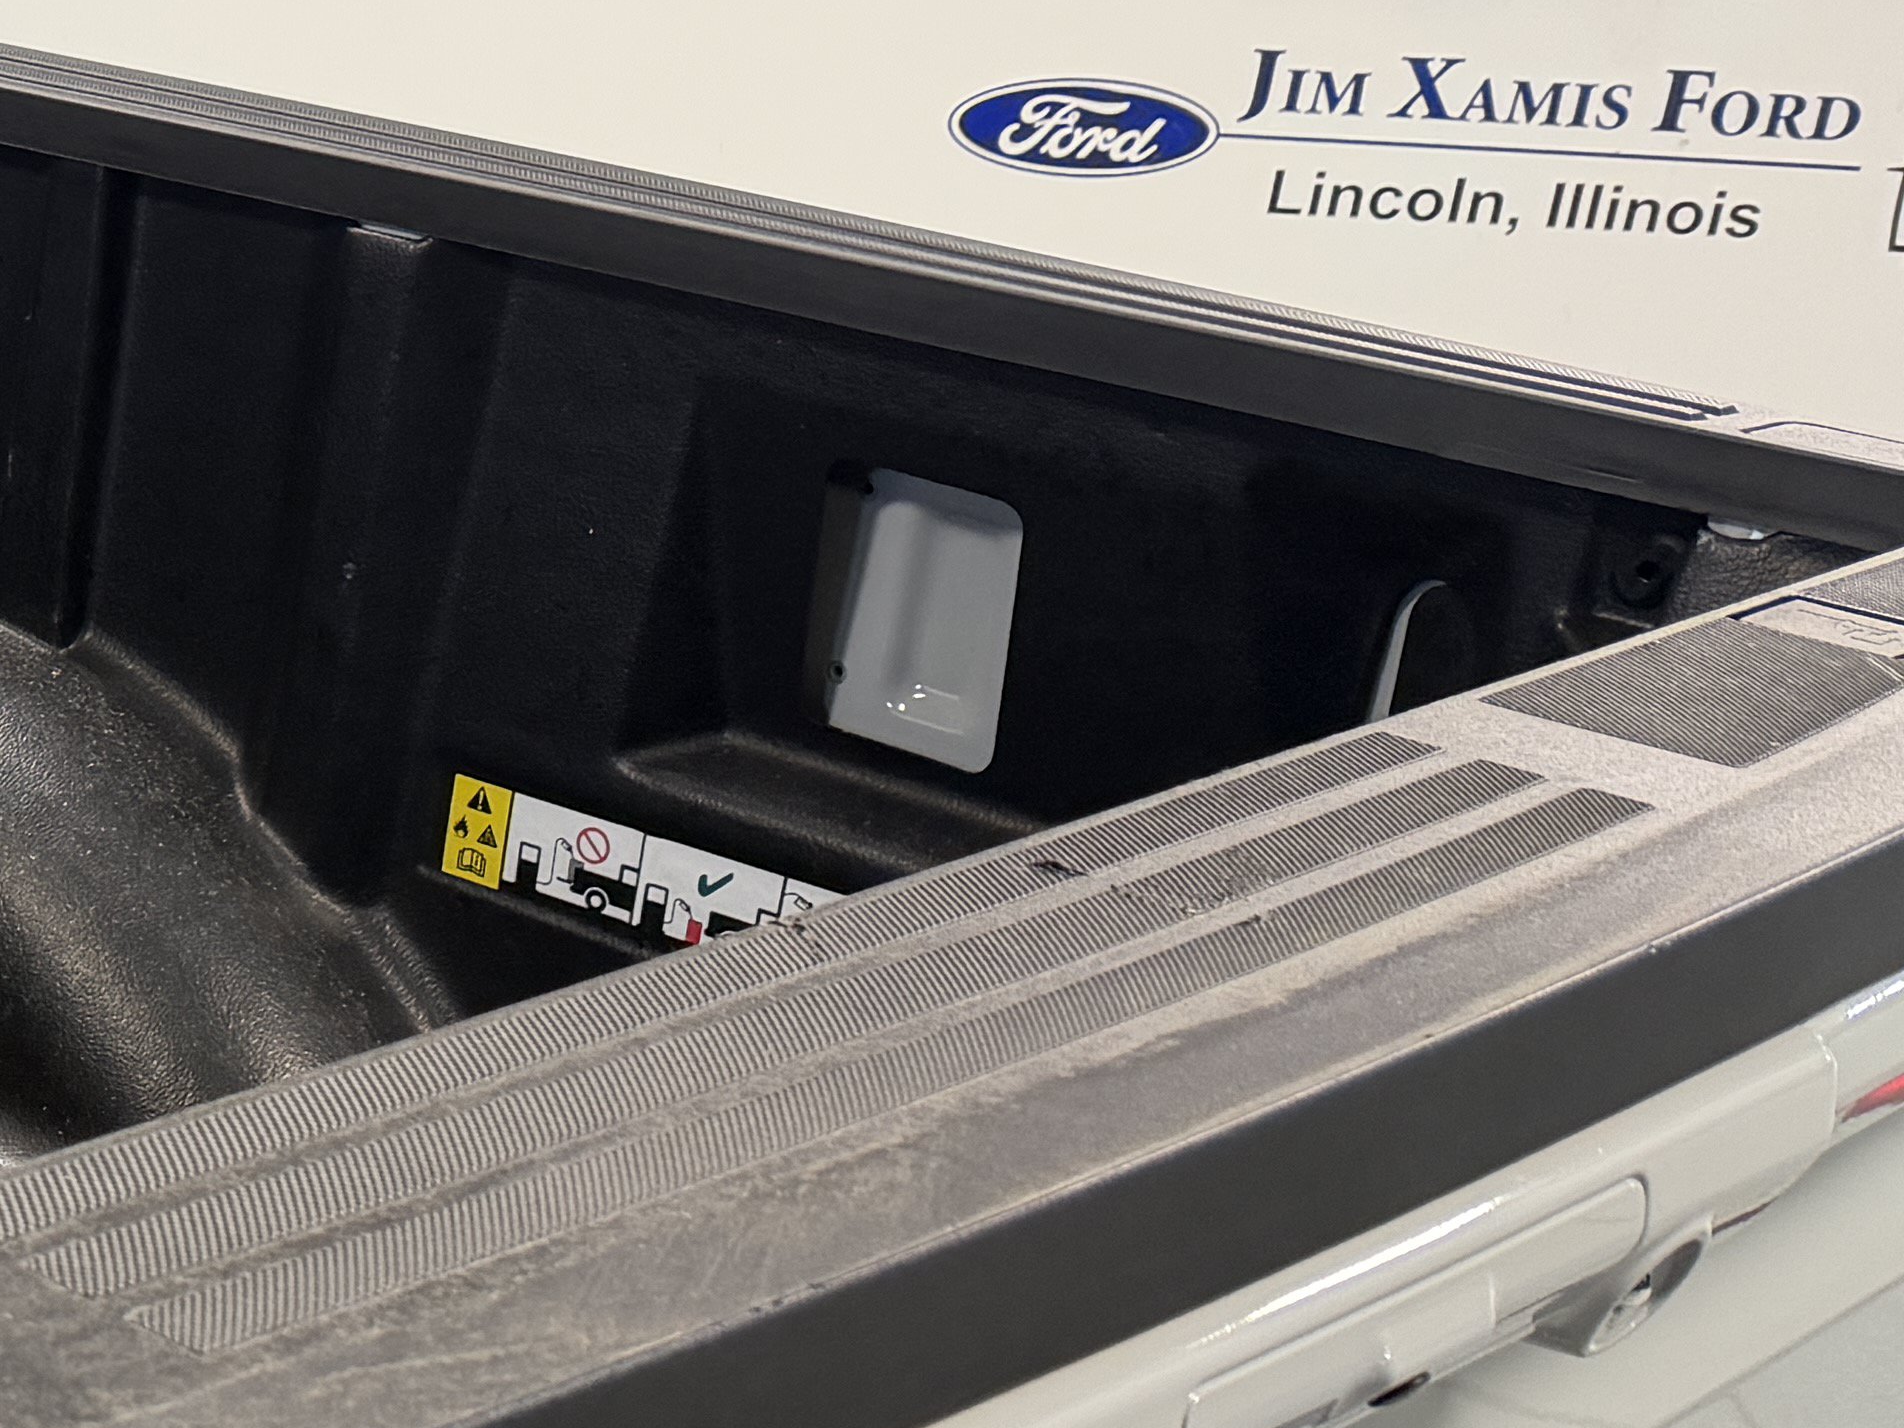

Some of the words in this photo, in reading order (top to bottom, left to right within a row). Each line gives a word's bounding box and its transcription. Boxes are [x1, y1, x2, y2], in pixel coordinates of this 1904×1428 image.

[1236, 48, 1372, 123] JIM
[1386, 56, 1632, 130] XAMIS
[1651, 69, 1861, 137] FORD
[997, 95, 1167, 163] Ford
[1266, 168, 1519, 236] Lincoln,
[1545, 178, 1761, 239] Illinois
